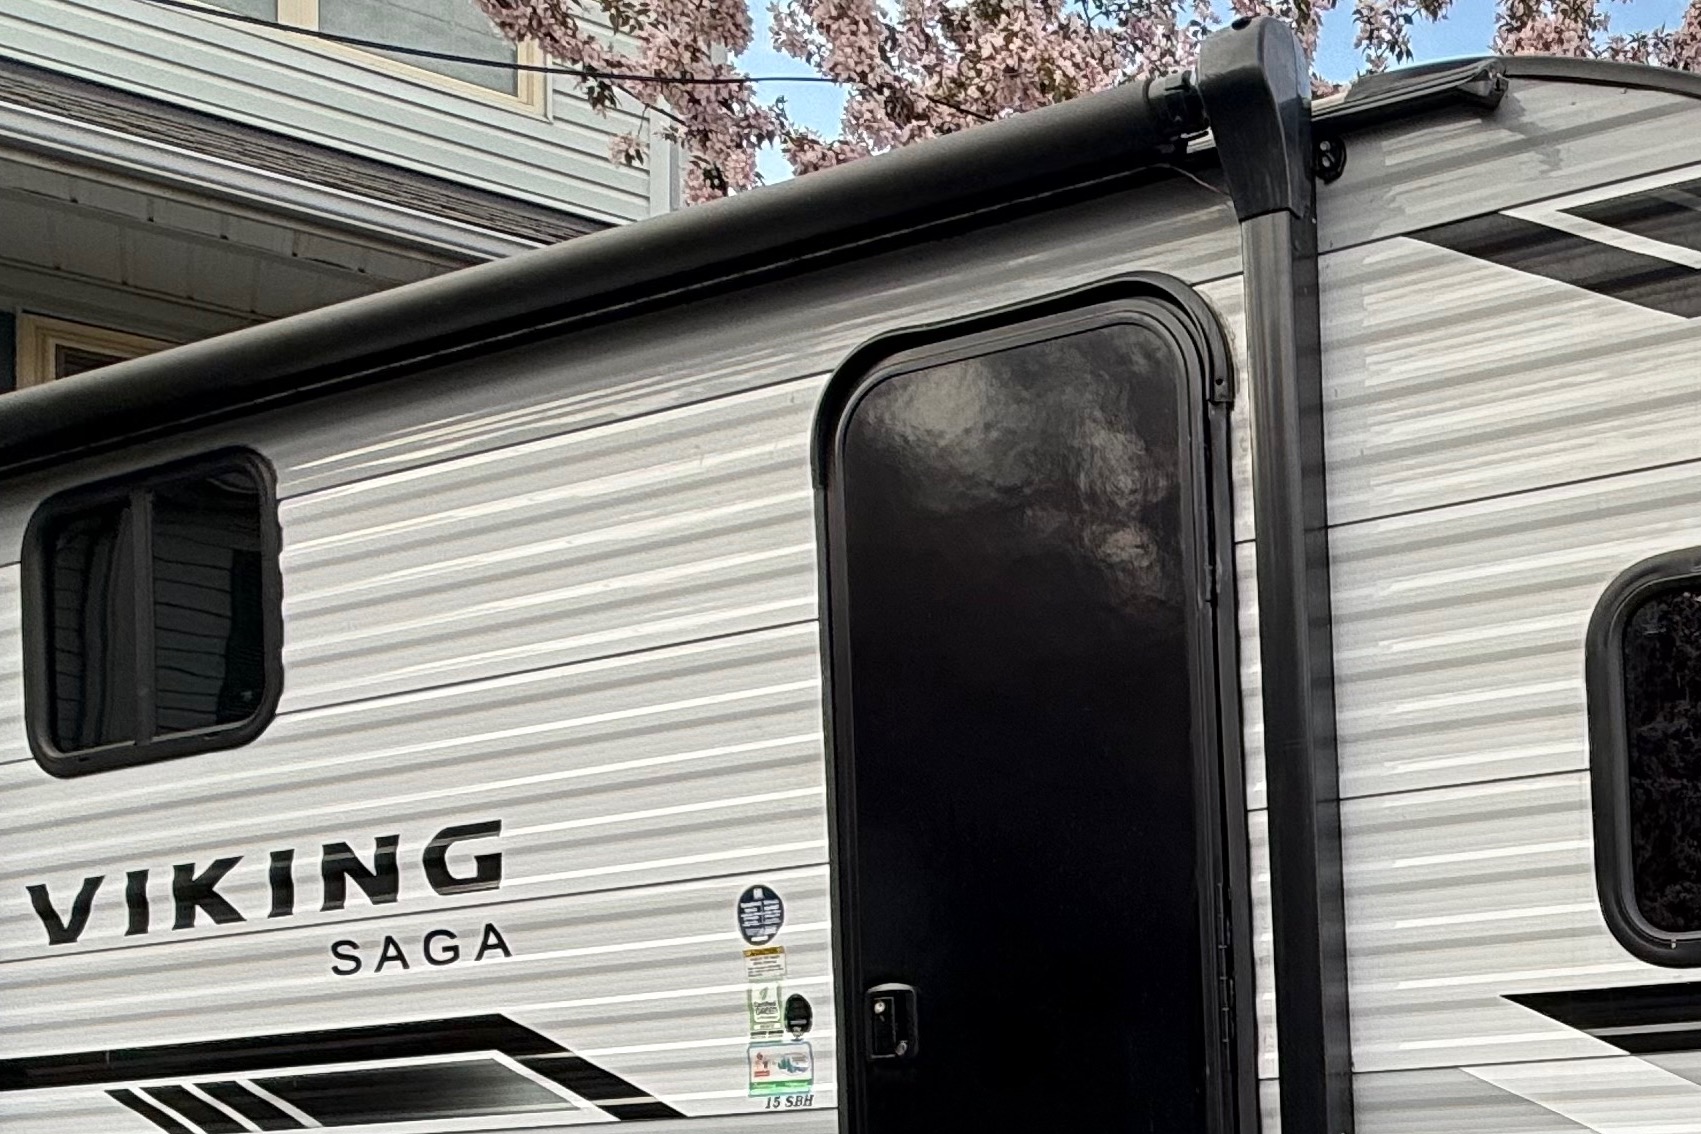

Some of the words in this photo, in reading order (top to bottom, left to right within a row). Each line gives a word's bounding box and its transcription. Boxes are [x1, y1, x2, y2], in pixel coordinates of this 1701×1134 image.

[26, 819, 502, 945] VIKING
[331, 923, 512, 975] SAGA
[765, 1096, 781, 1109] 15
[785, 1095, 814, 1108] SBH
